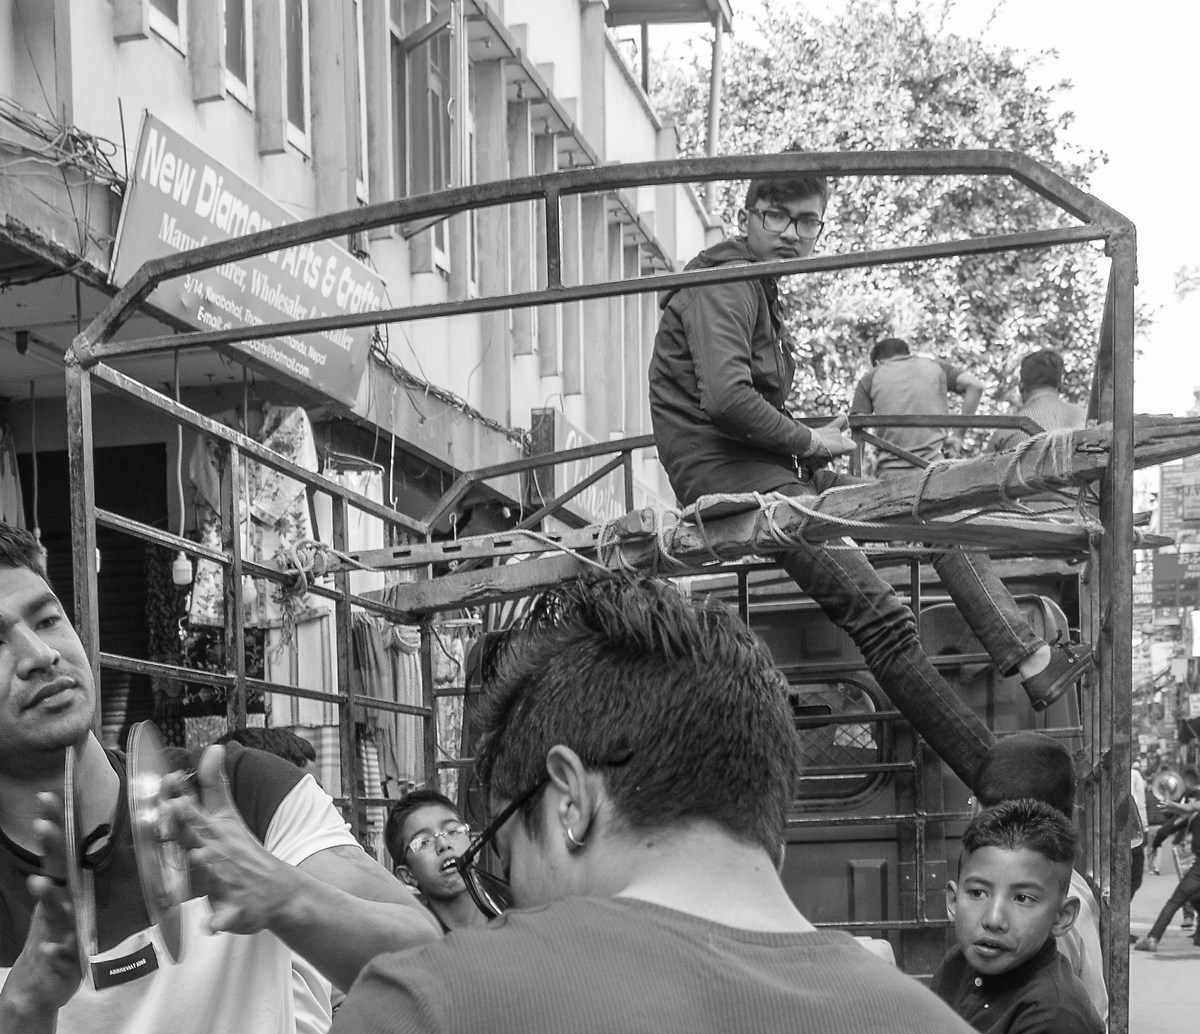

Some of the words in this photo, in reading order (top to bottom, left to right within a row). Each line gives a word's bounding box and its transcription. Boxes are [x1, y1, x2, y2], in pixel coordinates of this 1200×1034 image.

[140, 127, 197, 208] New
[321, 255, 338, 298] &
[250, 268, 308, 321] Wholesaler
